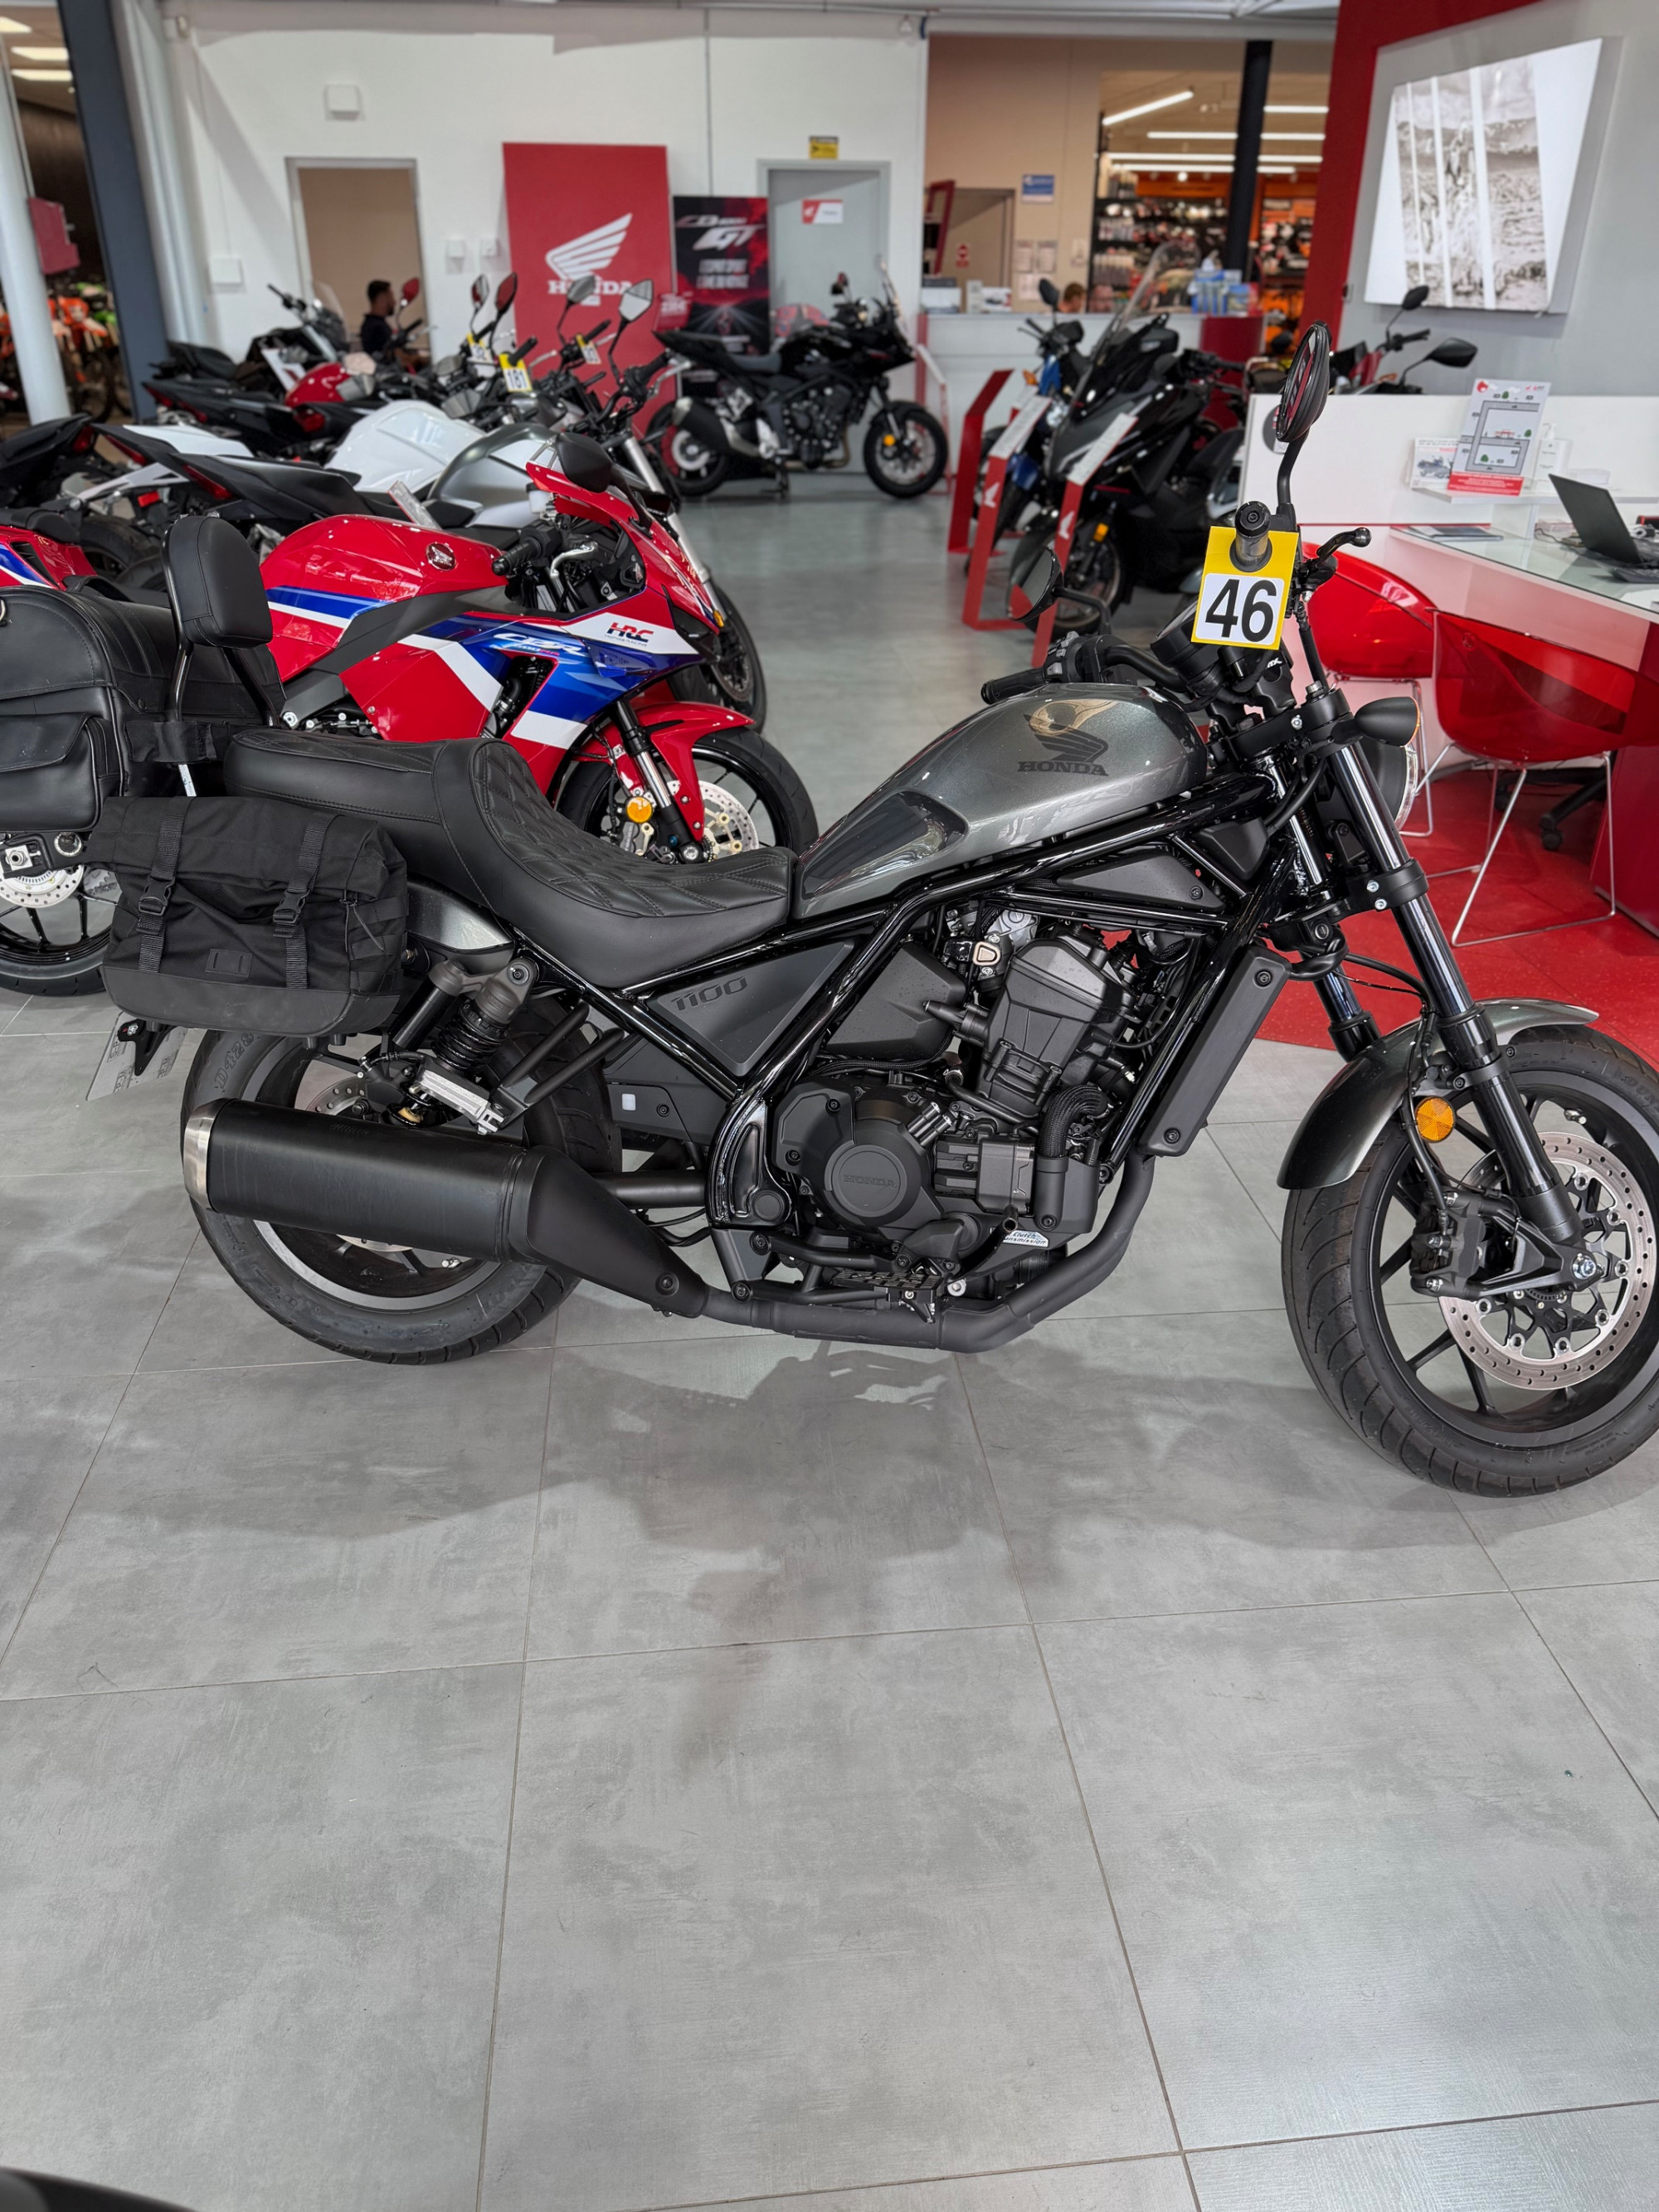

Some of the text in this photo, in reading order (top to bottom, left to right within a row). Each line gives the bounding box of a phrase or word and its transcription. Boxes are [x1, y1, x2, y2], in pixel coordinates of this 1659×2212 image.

[548, 280, 632, 294] HDA
[507, 370, 528, 388] 181
[1205, 578, 1277, 642] 46
[606, 622, 654, 643] HRC
[493, 633, 588, 658] CBR
[1017, 761, 1109, 776] HONDA
[671, 975, 747, 1011] 1100
[214, 1033, 255, 1089] D428
[843, 1174, 897, 1188] HONDA
[1005, 1236, 1046, 1245] ansmission
